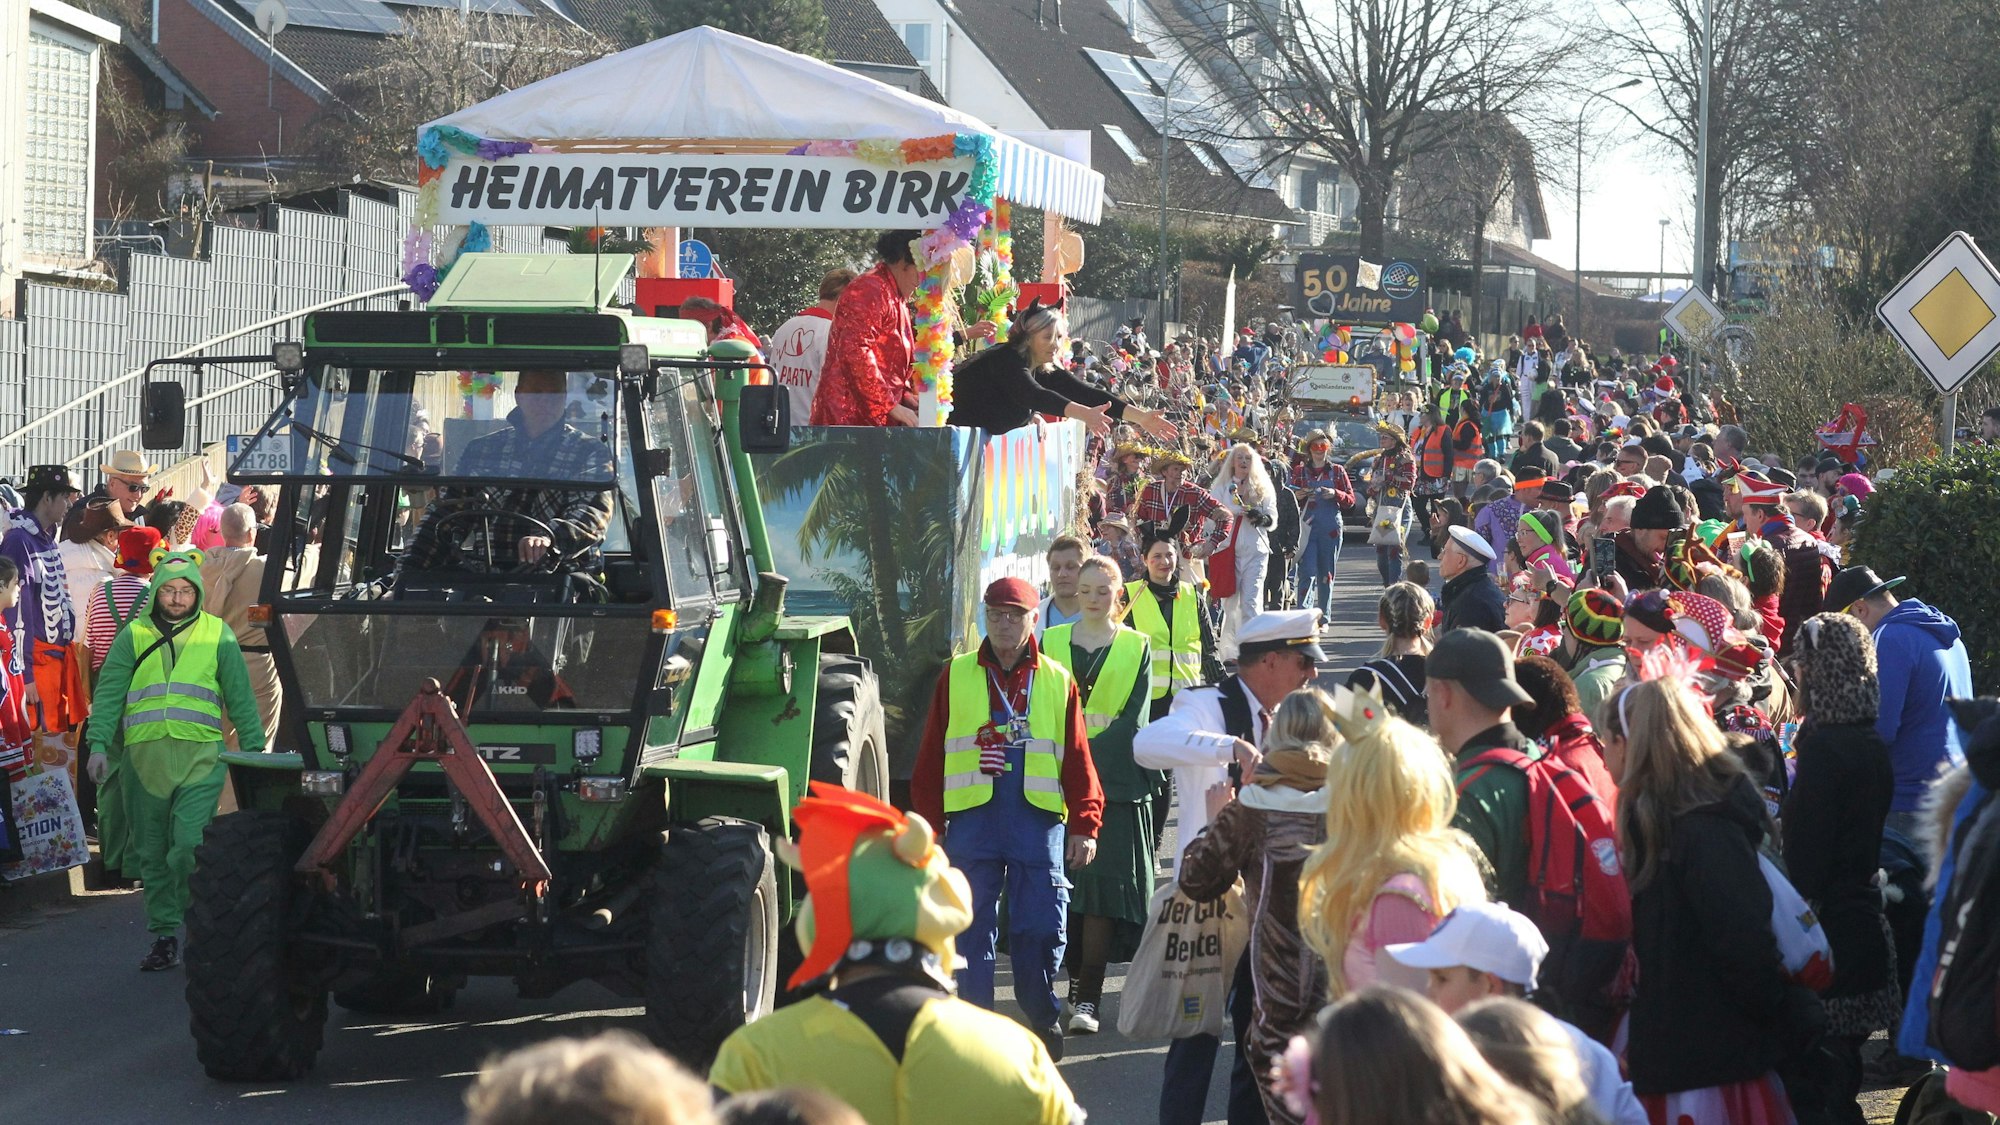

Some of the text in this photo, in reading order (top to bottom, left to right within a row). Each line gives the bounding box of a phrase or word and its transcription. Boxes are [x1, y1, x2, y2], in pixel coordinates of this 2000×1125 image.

[451, 165, 969, 217] HEIMATVEREIN BIRK
[1303, 264, 1347, 297] 50
[1337, 293, 1392, 313] Jahre
[779, 366, 812, 387] PARTY
[498, 686, 528, 695] KHD
[1157, 897, 1192, 925] Der
